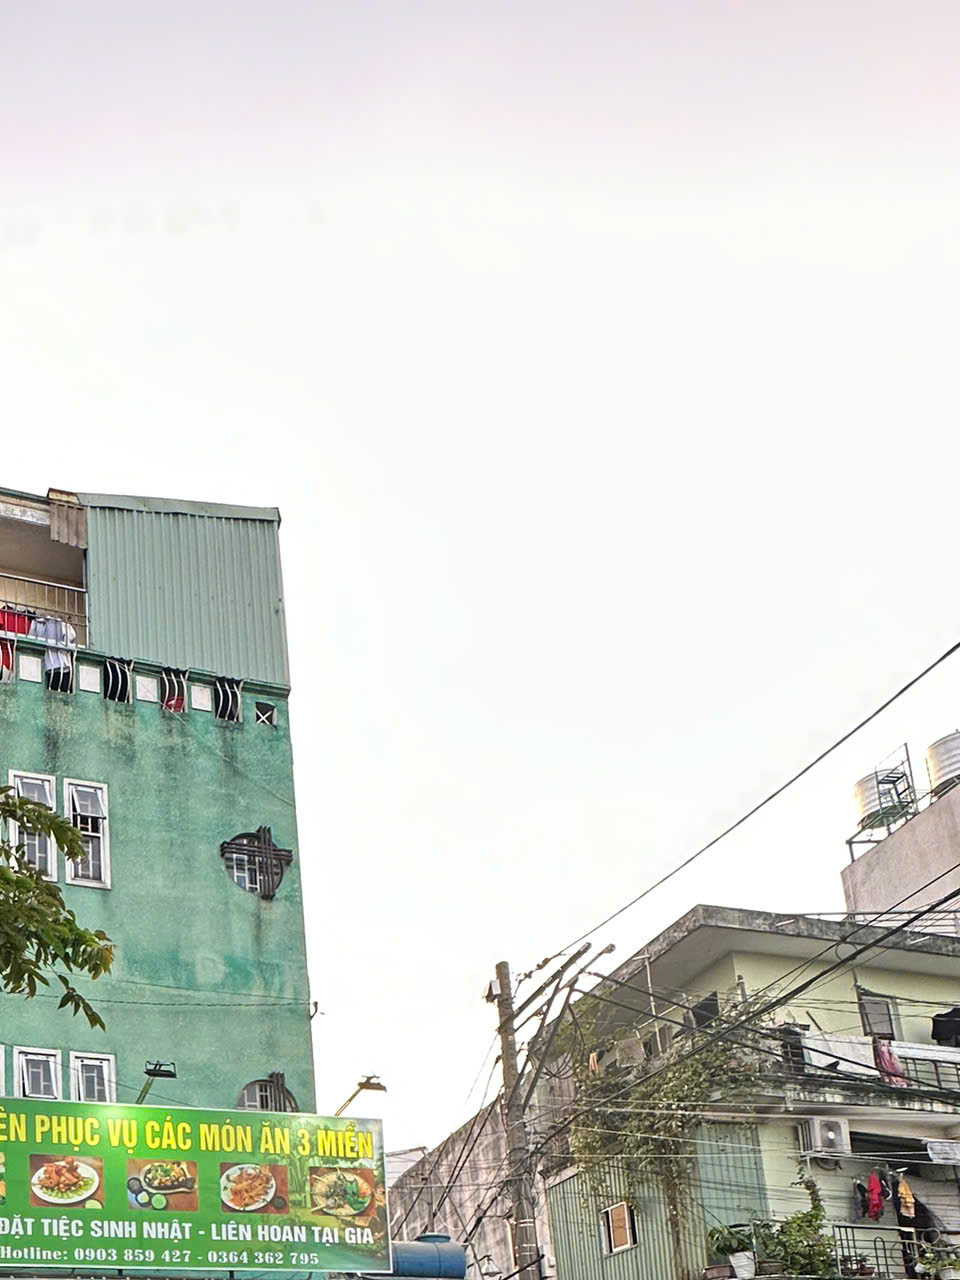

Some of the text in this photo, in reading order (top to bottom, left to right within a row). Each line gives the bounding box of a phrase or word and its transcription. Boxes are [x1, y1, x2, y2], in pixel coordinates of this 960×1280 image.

[35, 1114, 100, 1152] PHỤC
[108, 1118, 137, 1154] VỤ
[145, 1115, 192, 1150] CÁC
[199, 1119, 253, 1153] MÓN
[259, 1121, 290, 1155] ĂN
[297, 1128, 311, 1157] 3
[41, 1216, 84, 1241] TIỆC
[90, 1220, 137, 1238] SINH
[143, 1219, 192, 1243] NHẬT
[211, 1220, 251, 1241] LIÊN
[257, 1226, 307, 1243] HOAN
[311, 1226, 339, 1247] TẠI
[344, 1228, 374, 1245] GIA
[0, 1246, 68, 1261] Hotline:
[74, 1247, 118, 1261] 0903
[123, 1248, 155, 1262] 859
[161, 1250, 192, 1263] 427
[208, 1251, 248, 1264] 0364
[254, 1252, 284, 1264] 362
[290, 1252, 319, 1265] 795
